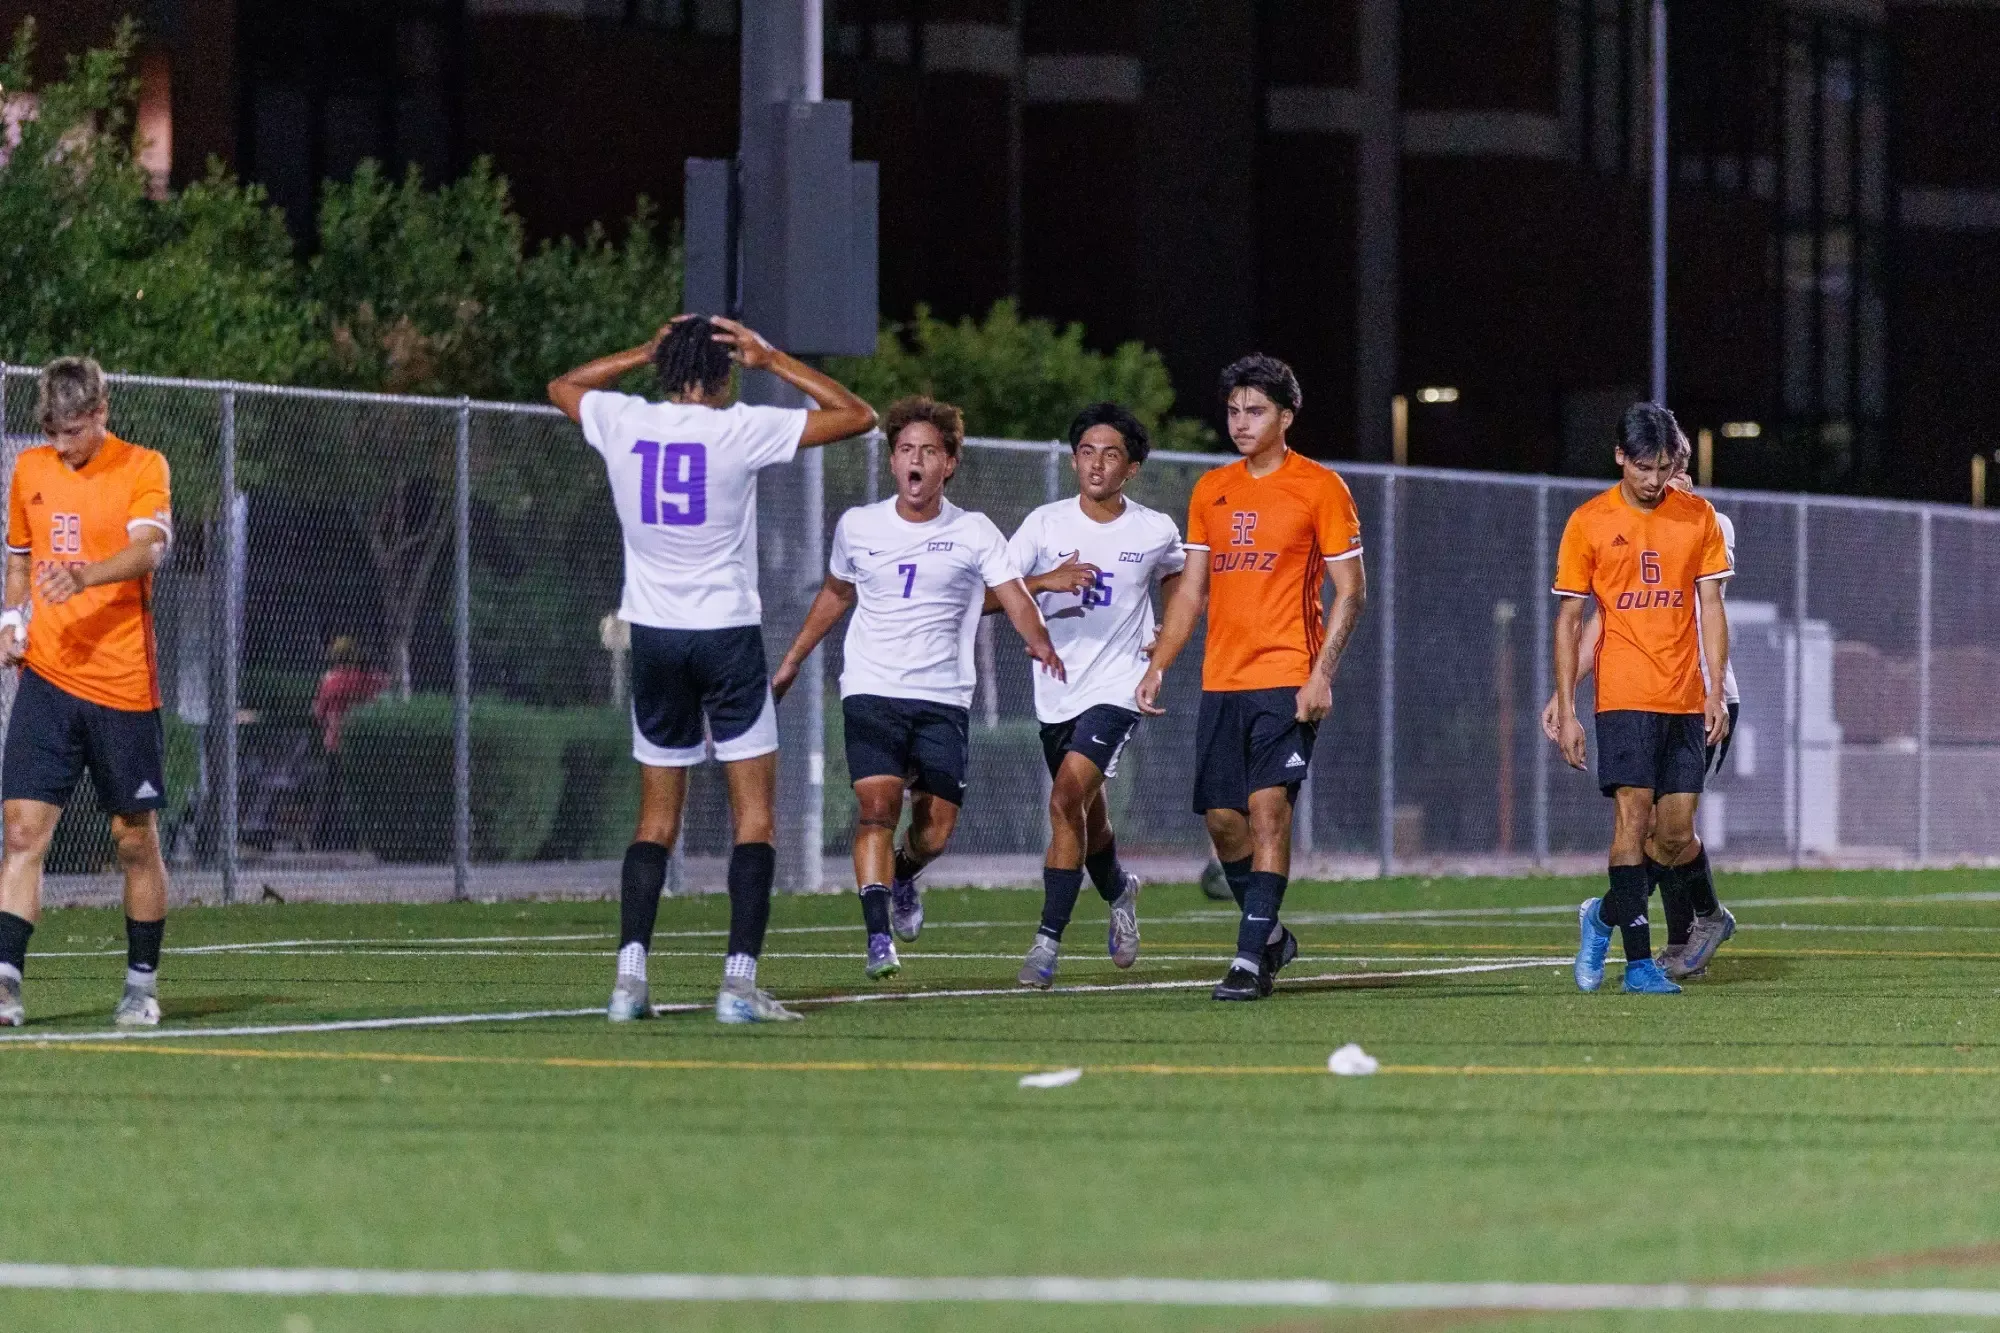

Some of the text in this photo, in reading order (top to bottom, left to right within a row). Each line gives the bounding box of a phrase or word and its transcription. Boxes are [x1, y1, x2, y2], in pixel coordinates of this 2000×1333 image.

[631, 440, 707, 525] 19
[51, 512, 81, 554] 28
[927, 541, 954, 552] GCU
[1231, 511, 1258, 547] 32
[1118, 551, 1145, 563] GCU
[1213, 551, 1279, 573] OUAZ
[1640, 550, 1662, 585] 6
[898, 563, 918, 599] 7
[1616, 589, 1684, 611] OUAZ
